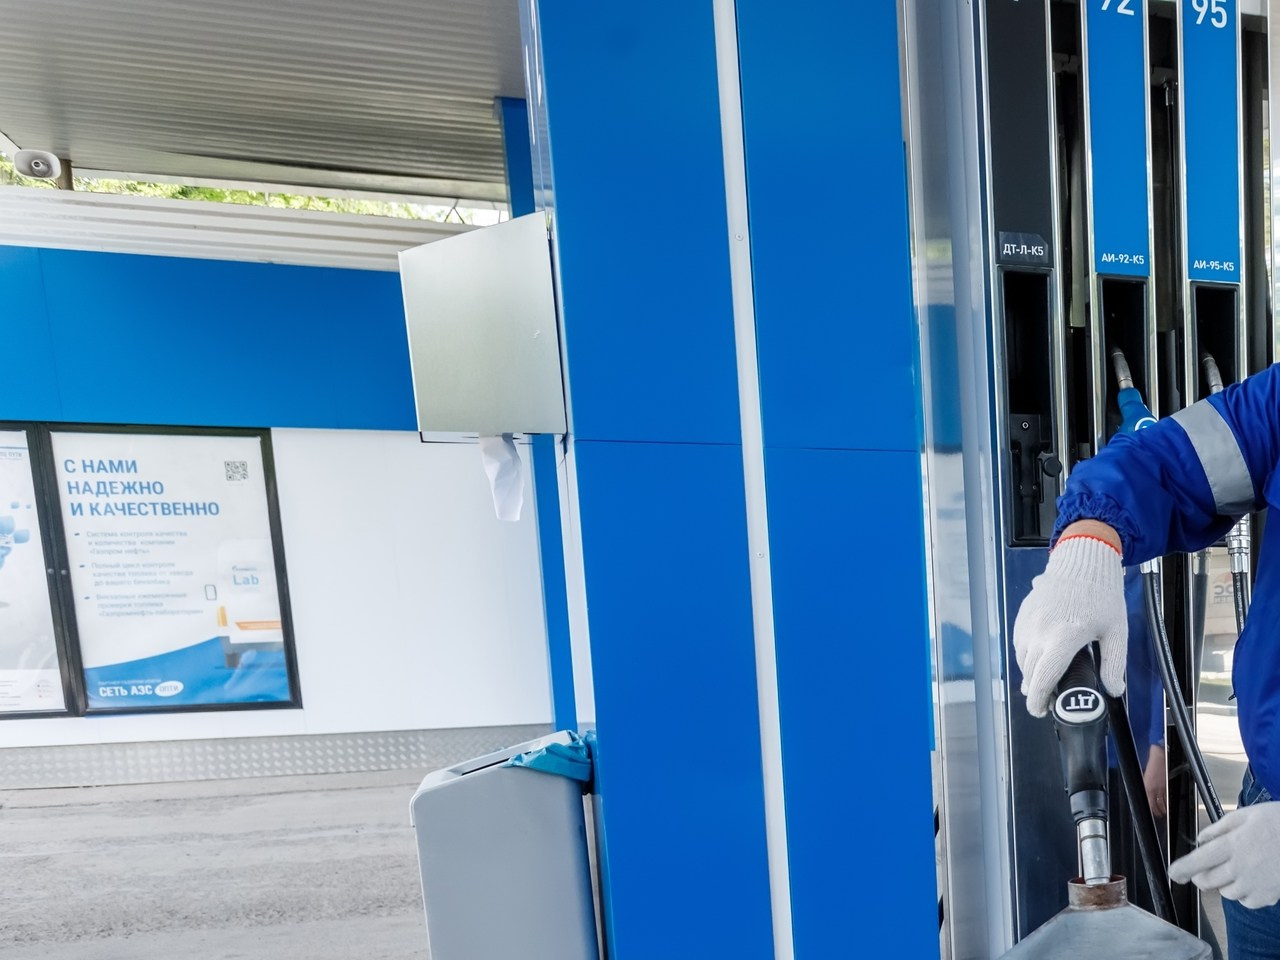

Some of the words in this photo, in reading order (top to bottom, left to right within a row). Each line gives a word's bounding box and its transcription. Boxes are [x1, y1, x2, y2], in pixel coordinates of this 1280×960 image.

[1003, 243, 1044, 256] ДТ-Л-К5
[1101, 252, 1145, 266] АИ-92-К5
[1193, 260, 1235, 273] АИ-95-К5
[64, 459, 76, 474] С
[82, 459, 138, 474] НАМИ
[67, 481, 164, 498] НАДЕЖНО
[70, 502, 83, 516] И
[90, 502, 220, 516] КАЧЕСТВЕННО
[232, 575, 260, 586] Lab
[99, 686, 128, 697] СЕТЬ
[130, 684, 153, 696] АЗС
[1066, 694, 1096, 710] ДТ
